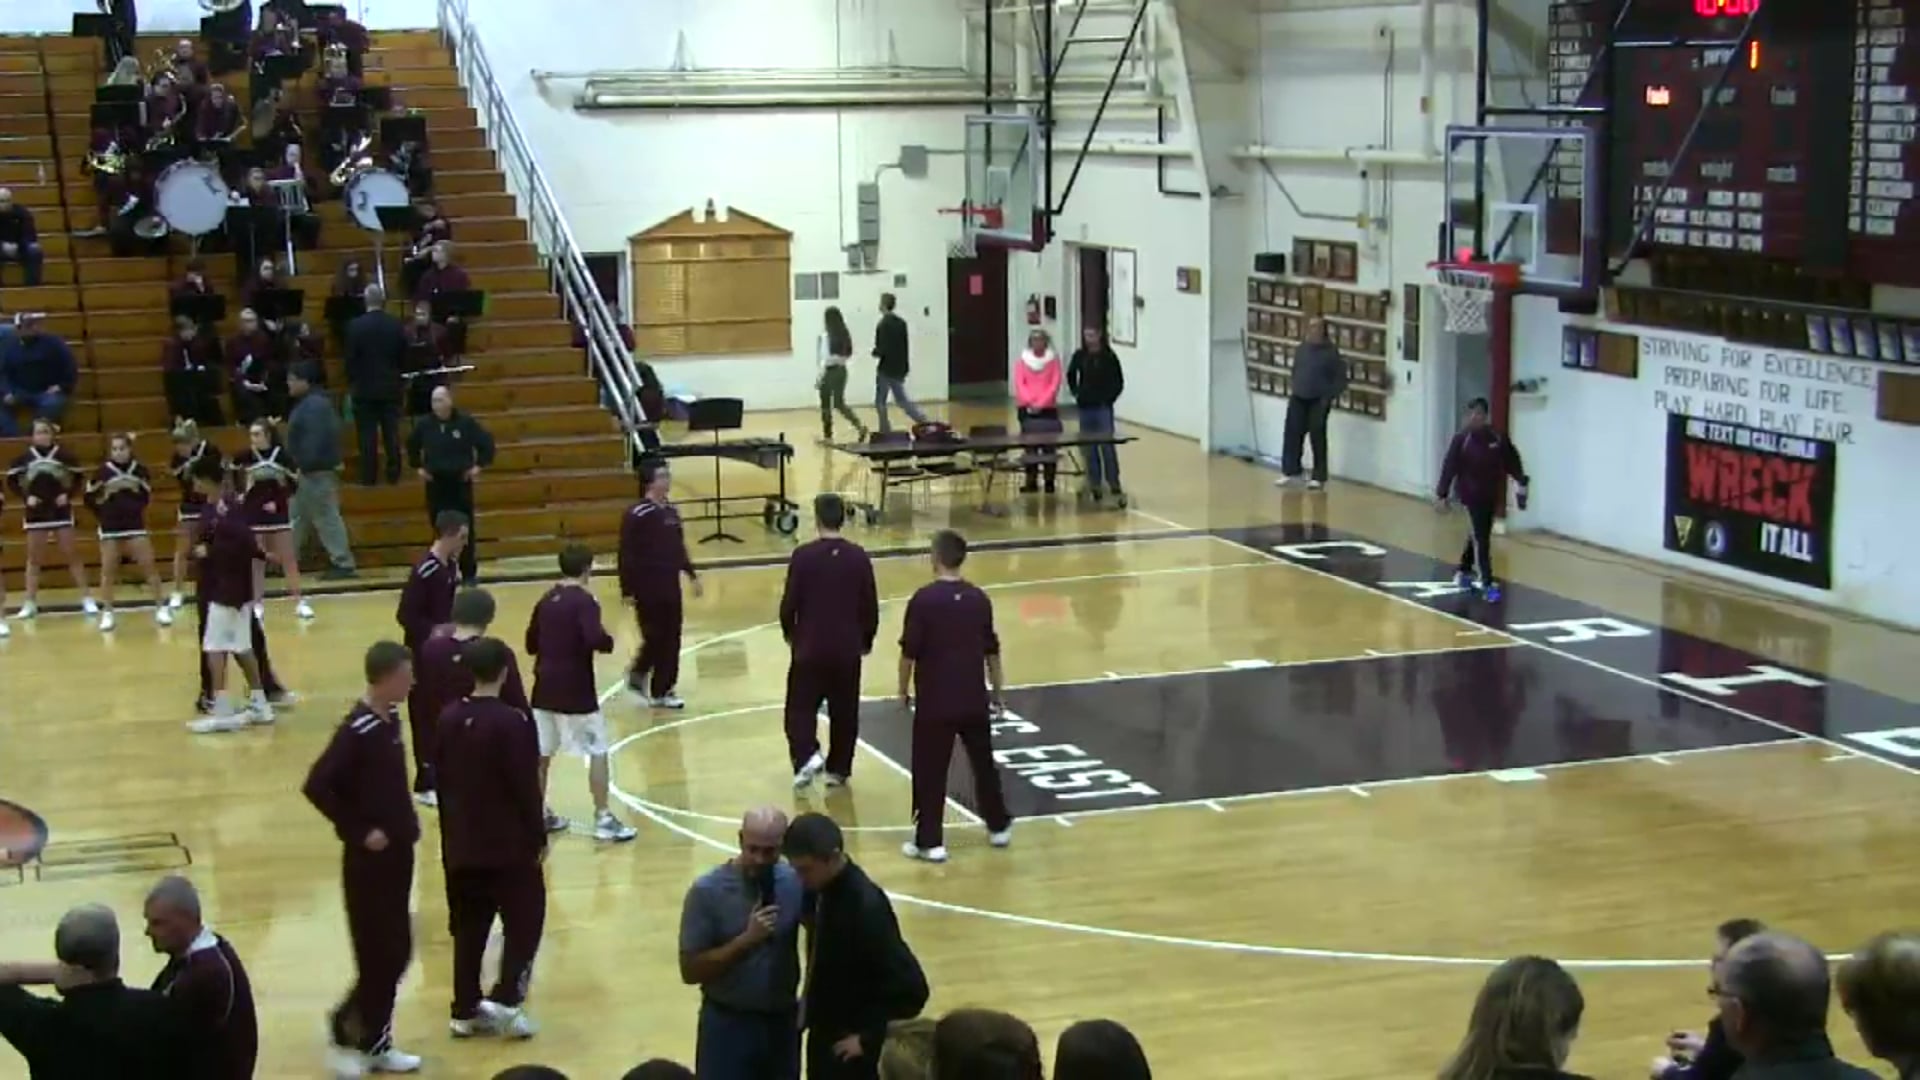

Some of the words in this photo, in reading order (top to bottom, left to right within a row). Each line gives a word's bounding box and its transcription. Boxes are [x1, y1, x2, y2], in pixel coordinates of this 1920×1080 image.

[1642, 337, 1710, 364] STRIVING
[1721, 347, 1752, 369] FOR
[1664, 366, 1749, 398] PREPARING
[1760, 381, 1791, 404] FOR
[1654, 390, 1692, 413] PLAY
[1760, 408, 1802, 434] PLAY
[1684, 443, 1816, 527] WRECK
[1761, 521, 1780, 553] IT
[1780, 527, 1813, 561] ALL
[992, 743, 1161, 799] EAST
